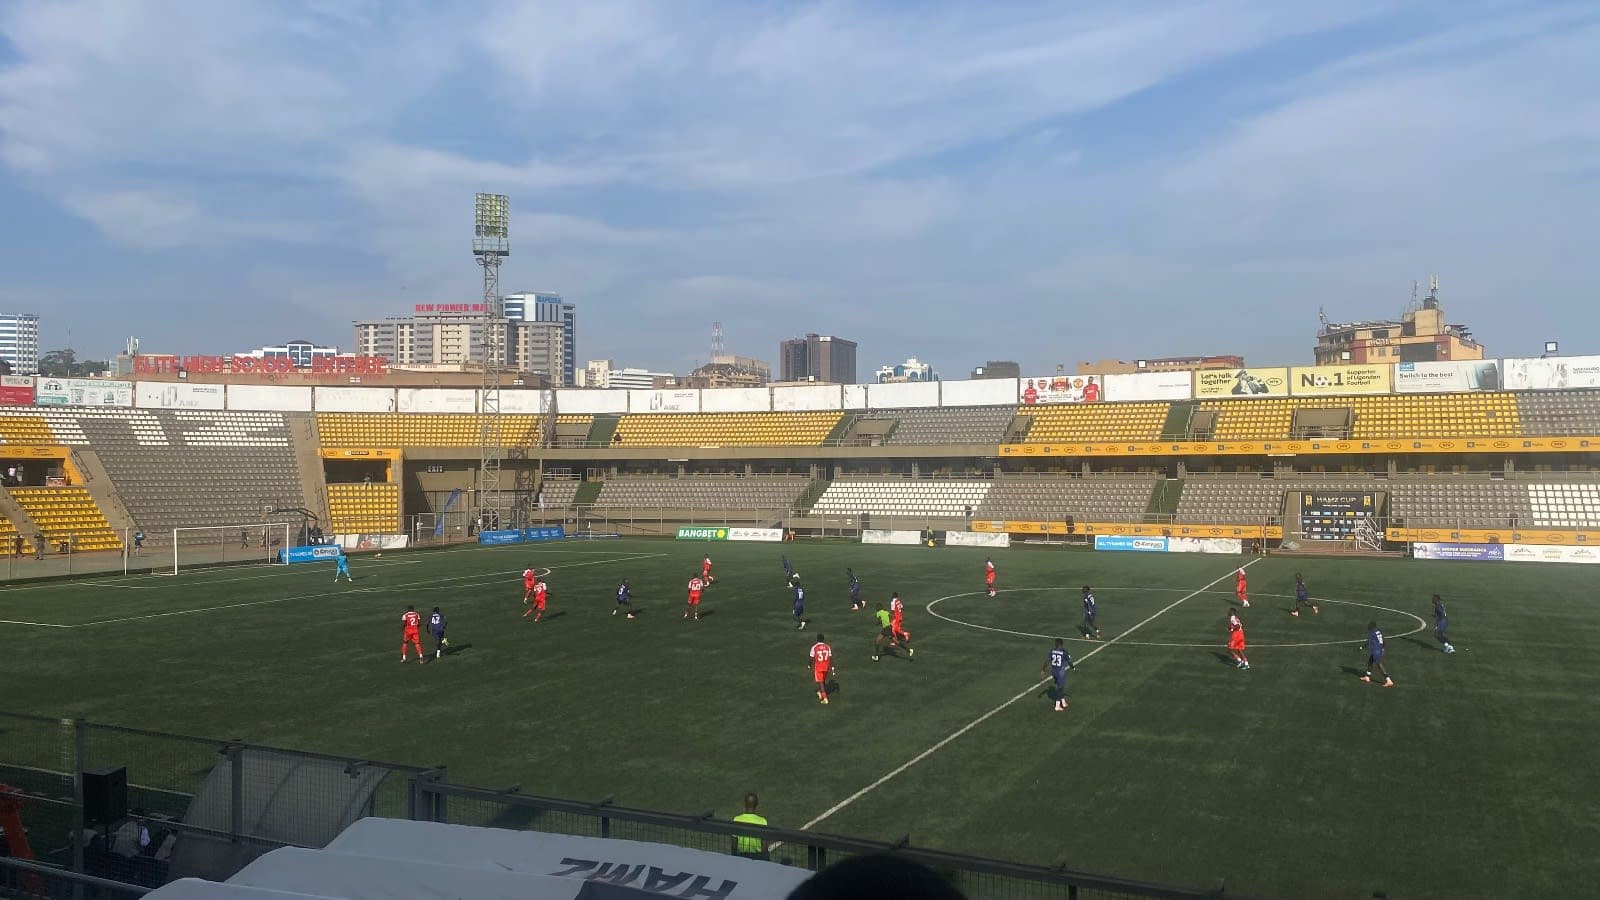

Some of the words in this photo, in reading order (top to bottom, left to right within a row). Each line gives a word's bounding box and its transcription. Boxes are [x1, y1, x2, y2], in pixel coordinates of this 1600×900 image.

[1370, 338, 1393, 346] HOTEL
[427, 465, 443, 473] EXIT
[678, 529, 717, 538] BANGBET
[410, 617, 417, 626] 2
[816, 649, 829, 661] 37
[1051, 654, 1062, 667] 23
